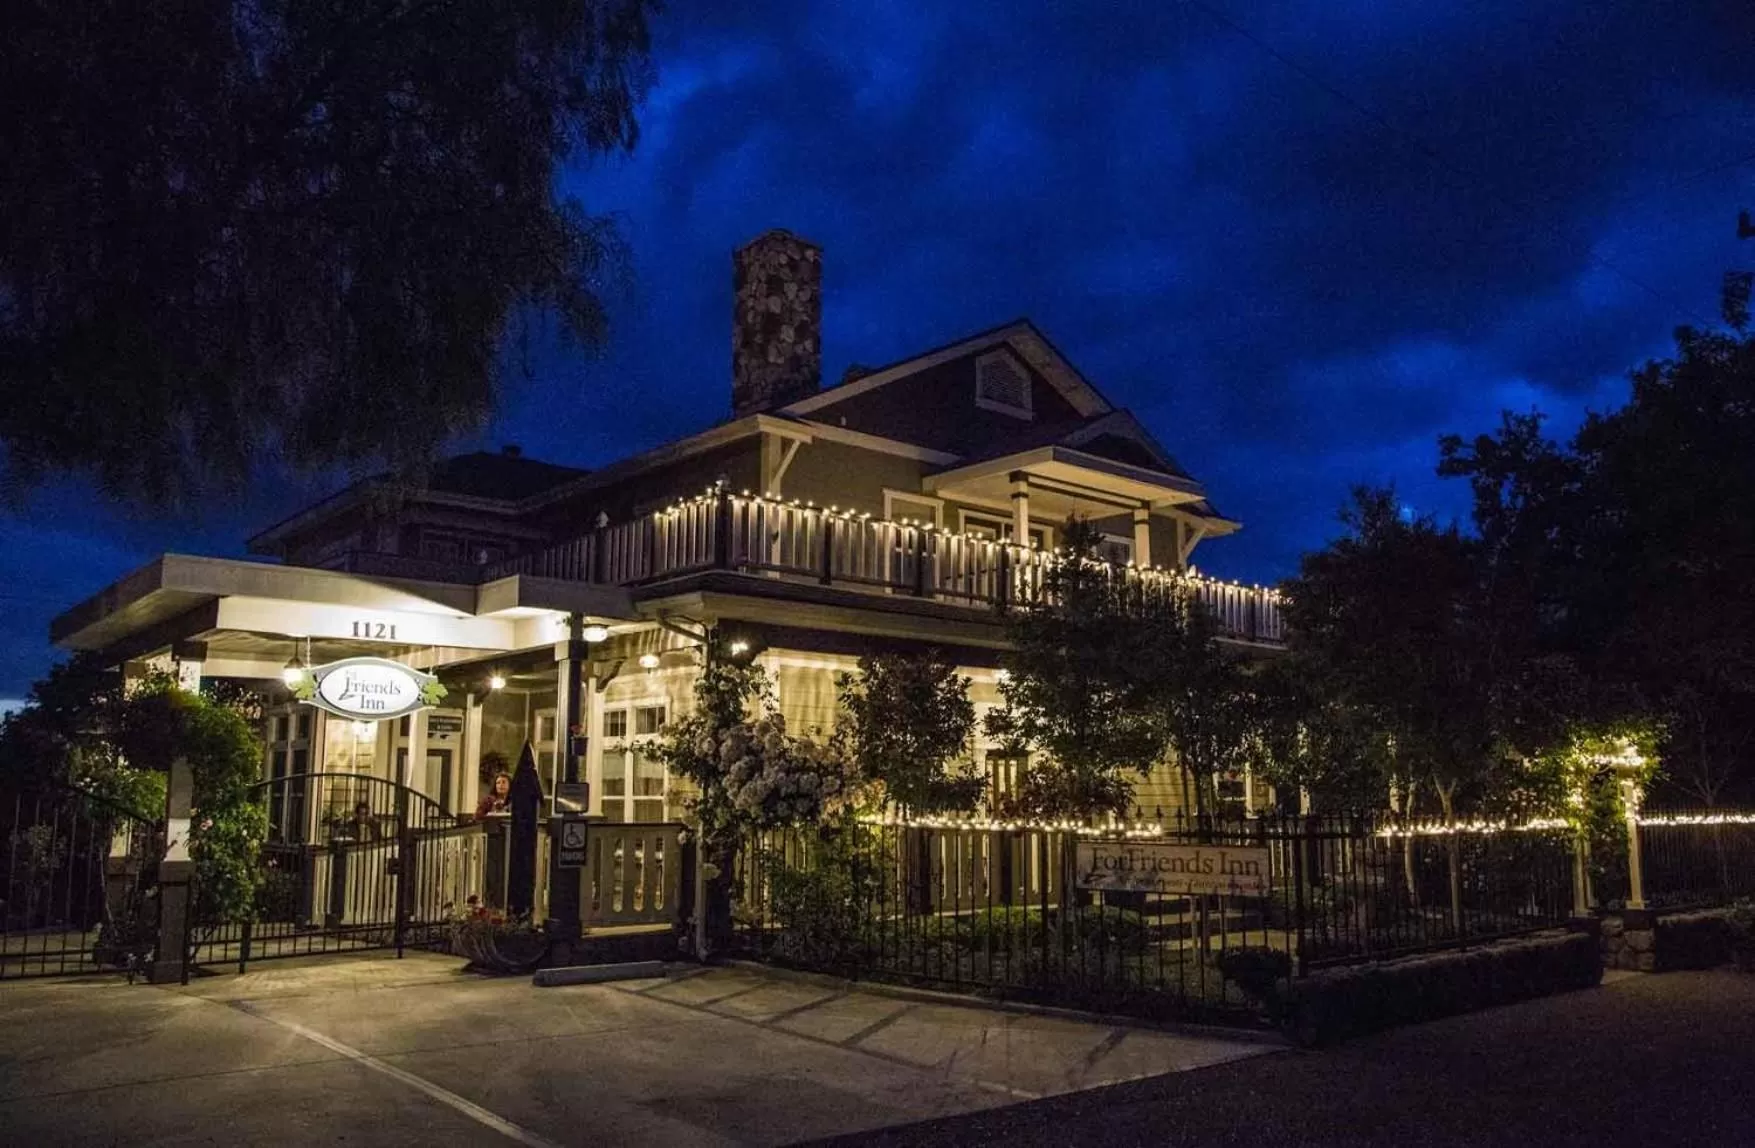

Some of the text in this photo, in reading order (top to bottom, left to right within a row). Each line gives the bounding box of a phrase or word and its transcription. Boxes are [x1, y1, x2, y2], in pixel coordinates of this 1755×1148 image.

[352, 621, 396, 639] 1121
[360, 694, 385, 710] Inn
[1219, 851, 1260, 877] Inn
